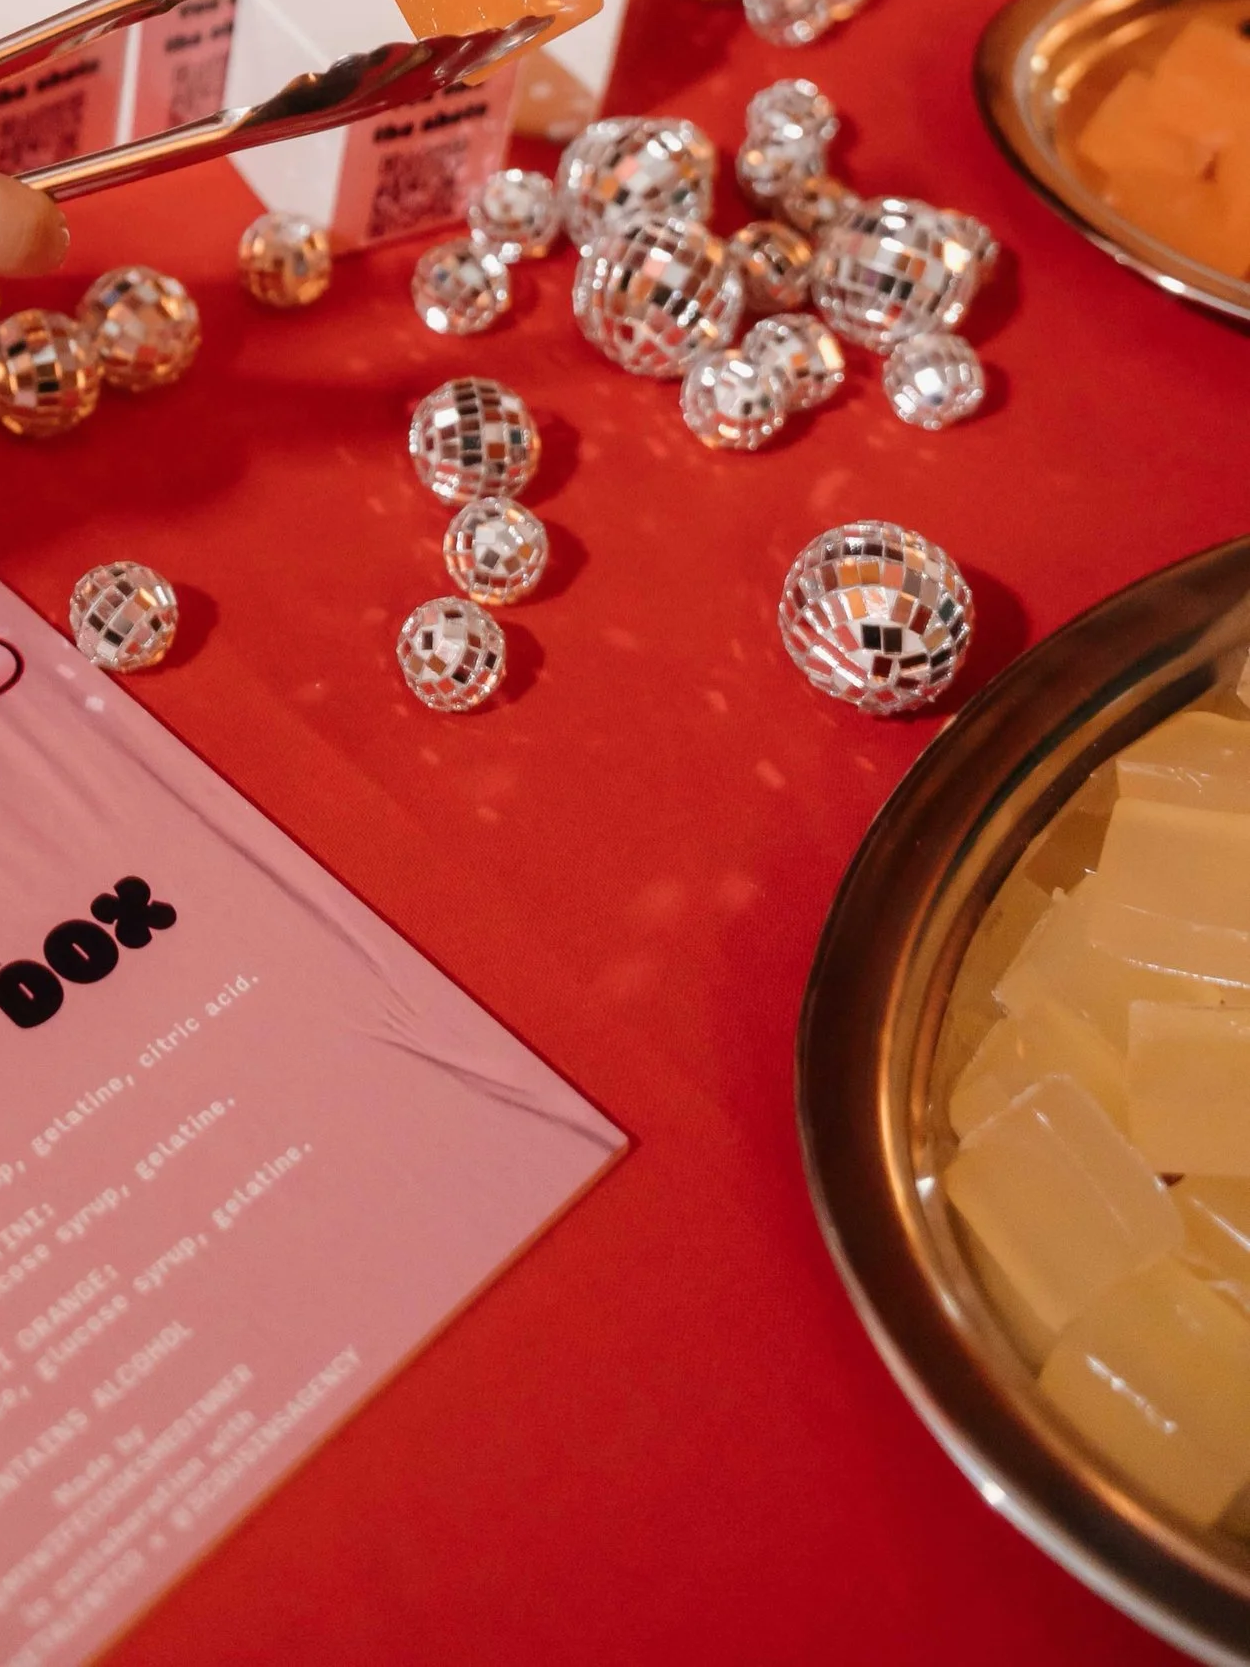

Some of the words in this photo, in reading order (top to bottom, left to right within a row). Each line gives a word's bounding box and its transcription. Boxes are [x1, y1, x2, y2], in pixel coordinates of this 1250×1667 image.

[31, 1074, 136, 1158] gelatine,
[139, 1016, 200, 1068] citric
[204, 974, 260, 1017] acid.
[56, 1184, 131, 1244] syrup,
[135, 1097, 236, 1181] gelatine.
[15, 1264, 119, 1353] ORANGE:
[35, 1294, 128, 1382] glucose
[132, 1233, 209, 1295] syrup,
[211, 1142, 313, 1231] gelatine.
[91, 1320, 195, 1410] ALCOHOL
